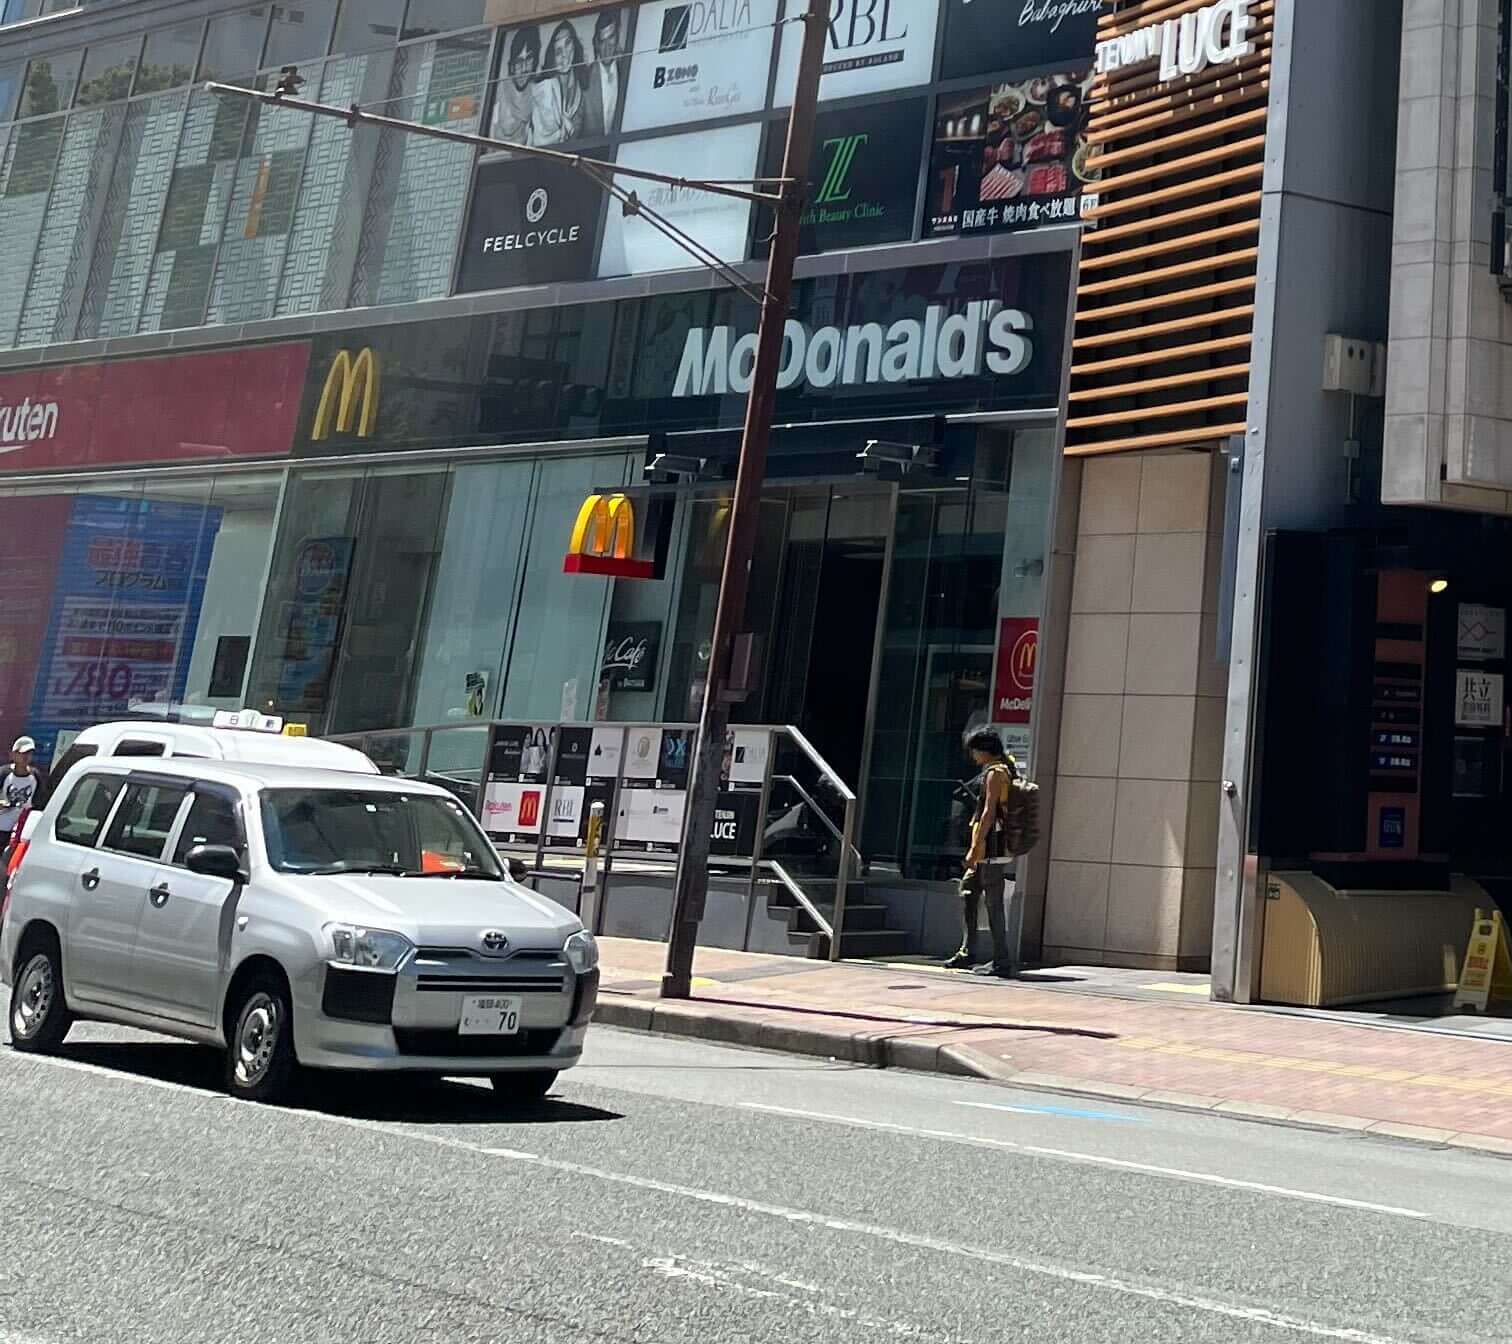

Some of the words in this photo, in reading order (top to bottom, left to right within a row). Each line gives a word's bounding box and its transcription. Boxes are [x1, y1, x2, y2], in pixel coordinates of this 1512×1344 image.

[961, 205, 1000, 229] 国産牛
[1002, 197, 1077, 224] 焼肉食べ放題
[482, 224, 581, 254] FEELCYCLE
[672, 299, 1033, 398] McDonald's
[1462, 675, 1492, 702] 共立
[710, 821, 737, 840] UCE
[498, 1011, 518, 1031] 70
